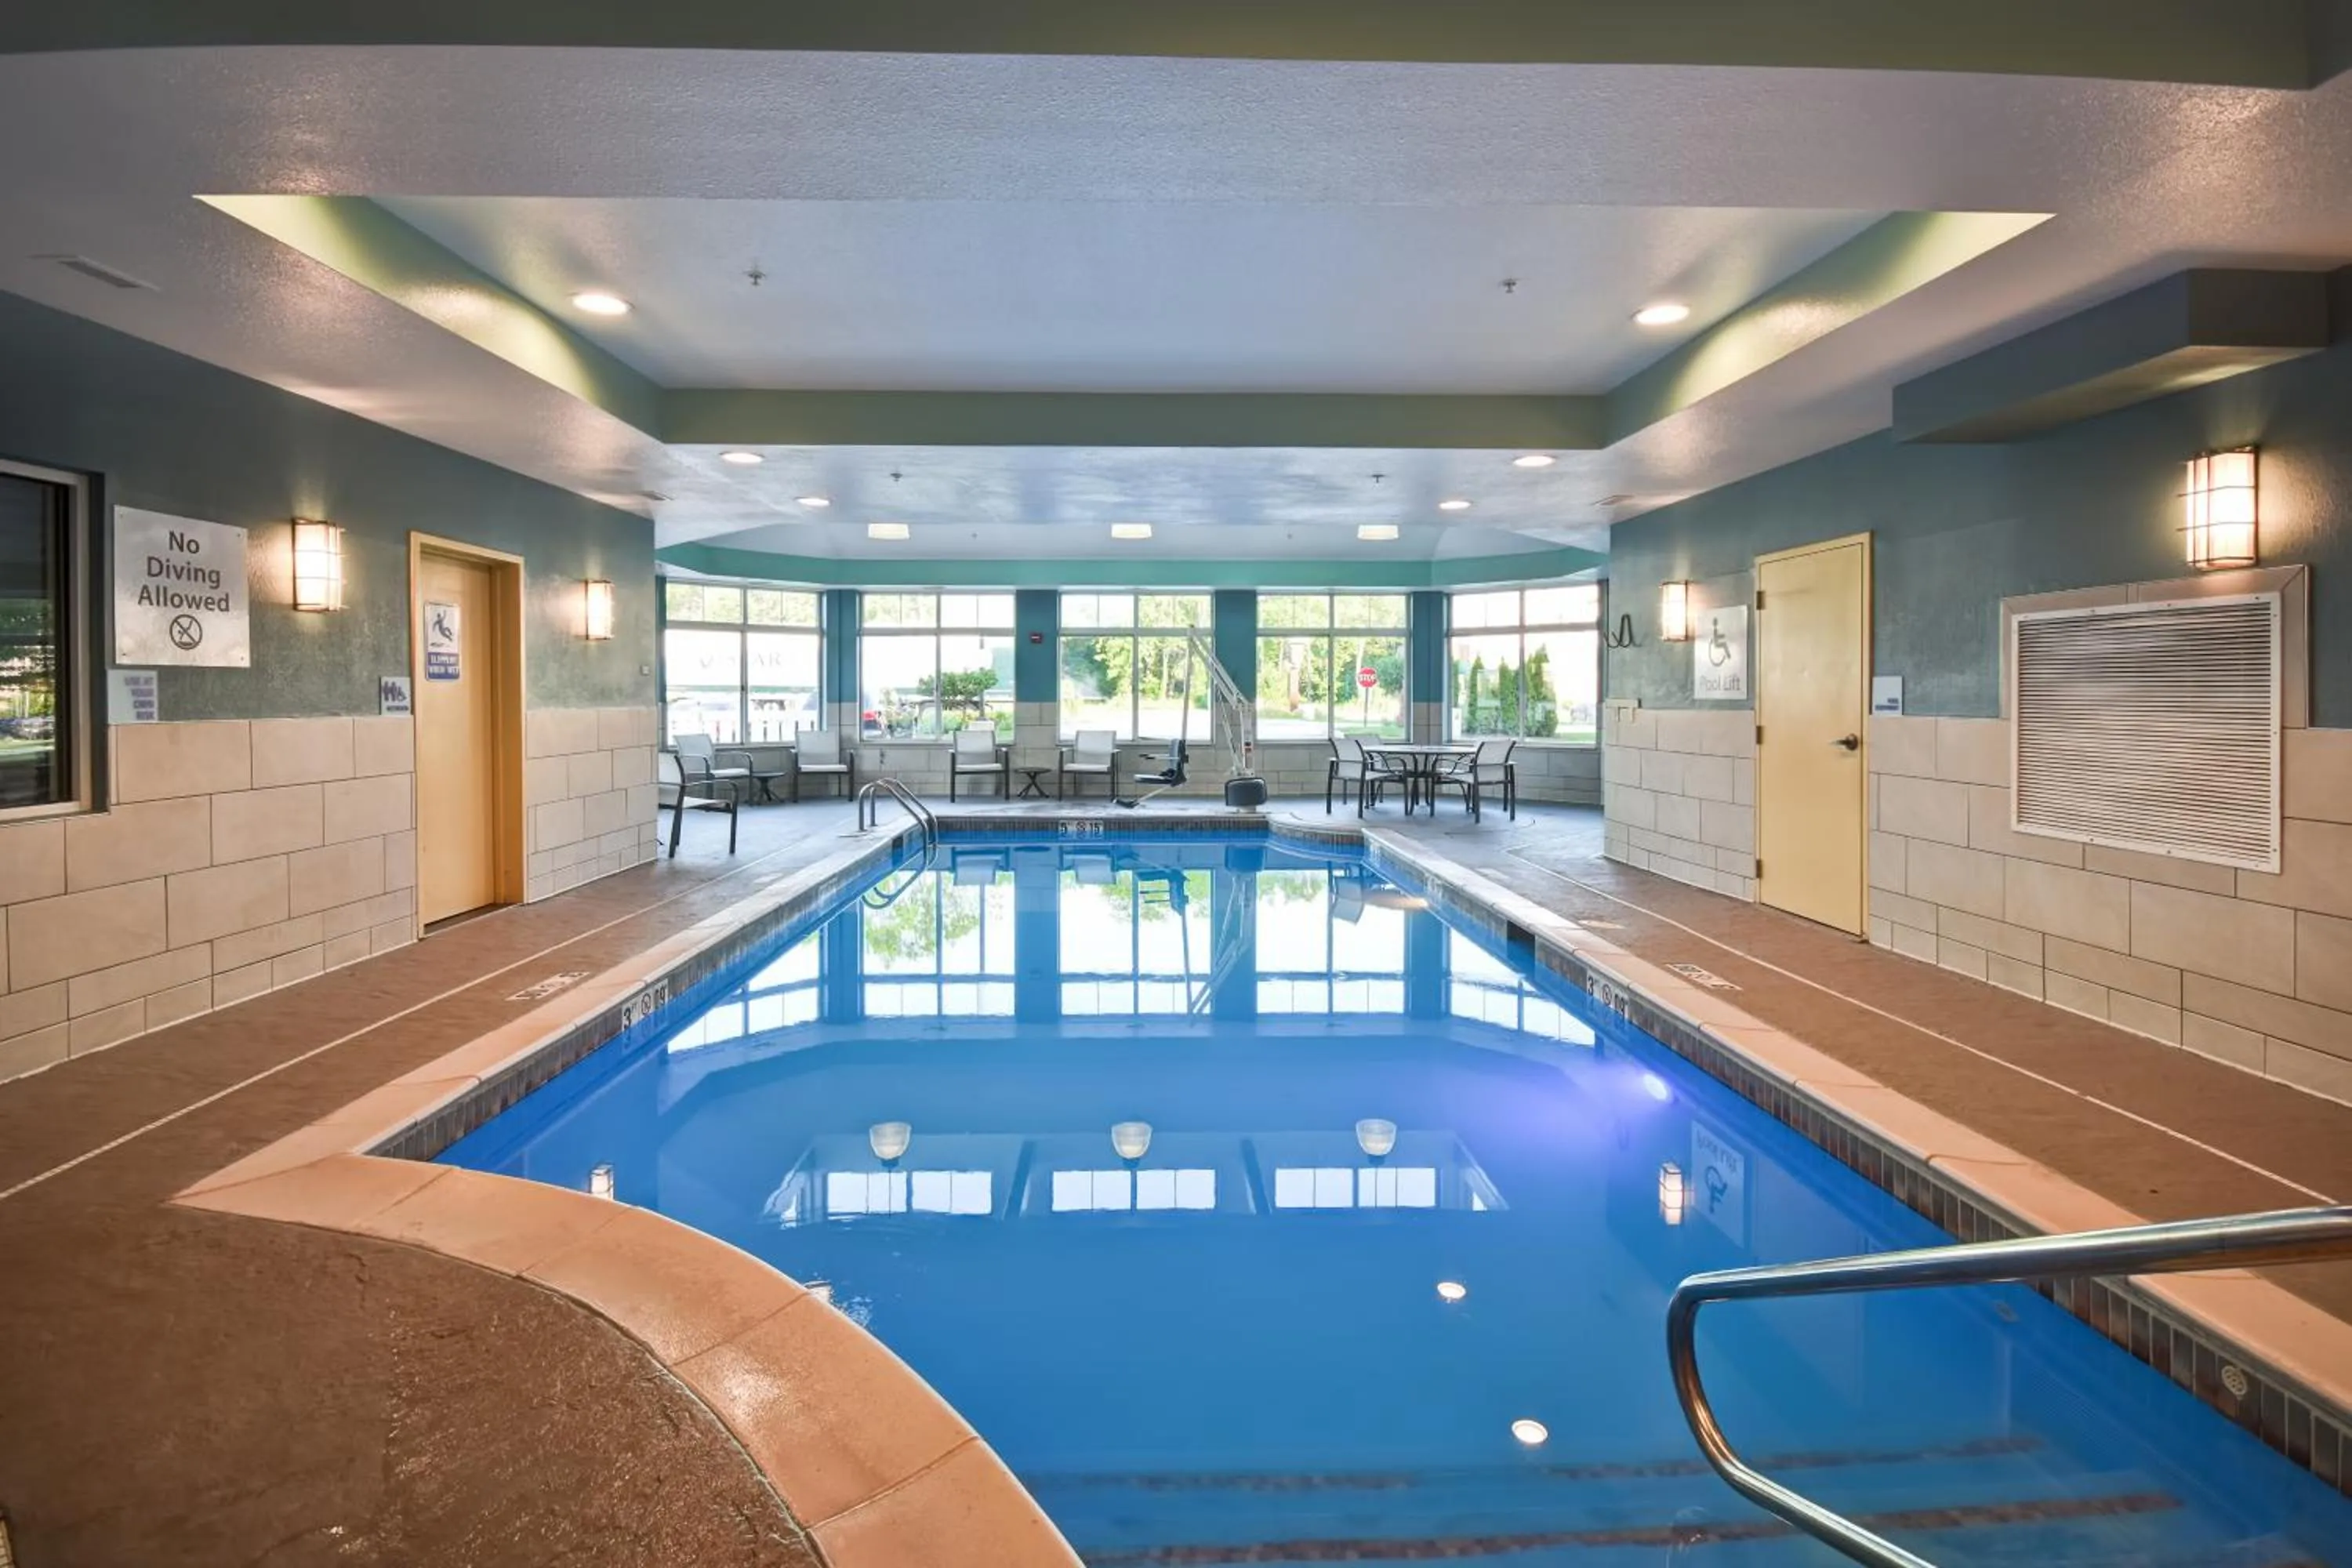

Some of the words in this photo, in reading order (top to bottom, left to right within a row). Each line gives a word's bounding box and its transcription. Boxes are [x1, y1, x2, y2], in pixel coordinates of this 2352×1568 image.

[169, 530, 201, 554] No
[147, 556, 220, 590] Diving
[138, 585, 230, 612] Allowed
[1700, 674, 1721, 691] Pool
[1723, 673, 1740, 691] Lift
[1588, 975, 1594, 996] 3
[623, 1007, 632, 1029] 3
